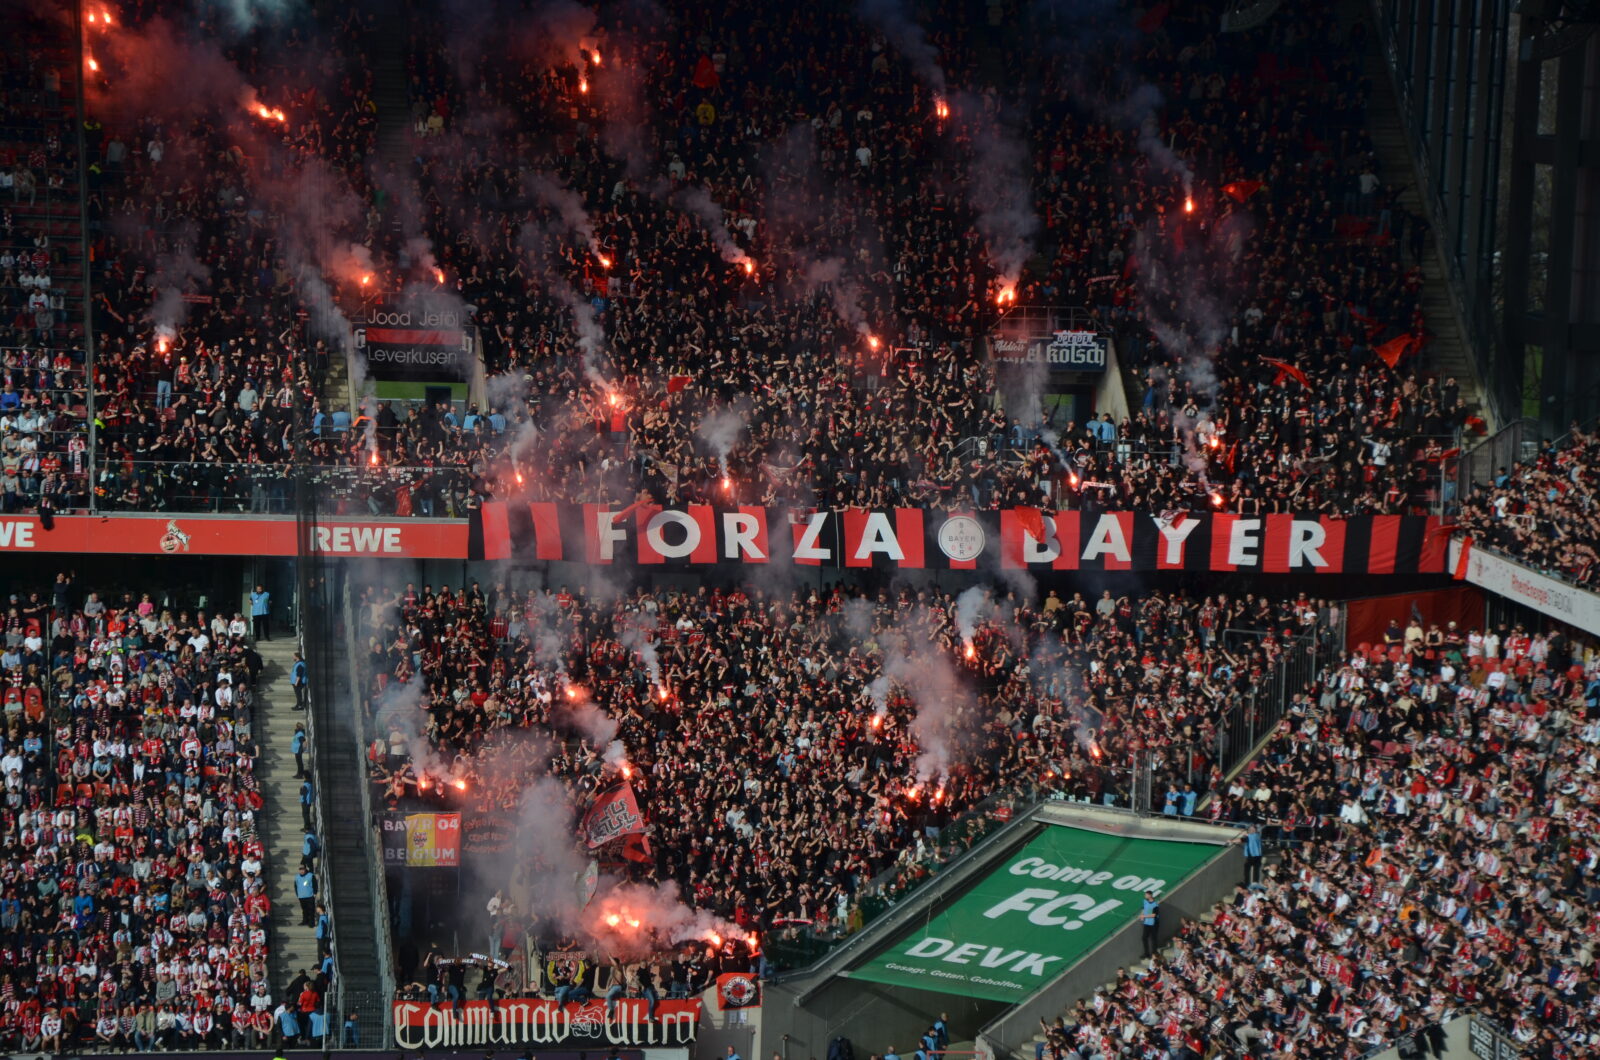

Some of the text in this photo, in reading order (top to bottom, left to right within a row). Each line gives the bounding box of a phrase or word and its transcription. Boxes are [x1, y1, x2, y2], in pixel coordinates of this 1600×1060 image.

[367, 308, 411, 326] Jood
[367, 345, 457, 365] Leverkusen
[310, 526, 402, 552] REWE
[597, 510, 1330, 568] FORZA BAYER
[384, 818, 459, 832] BAYER 04
[385, 847, 455, 860] BELGIUM
[1009, 857, 1114, 886] Come
[983, 888, 1124, 931] FC!
[885, 963, 927, 975] Gesagt.
[904, 937, 1063, 976] DEVK
[395, 1002, 570, 1049] Commando
